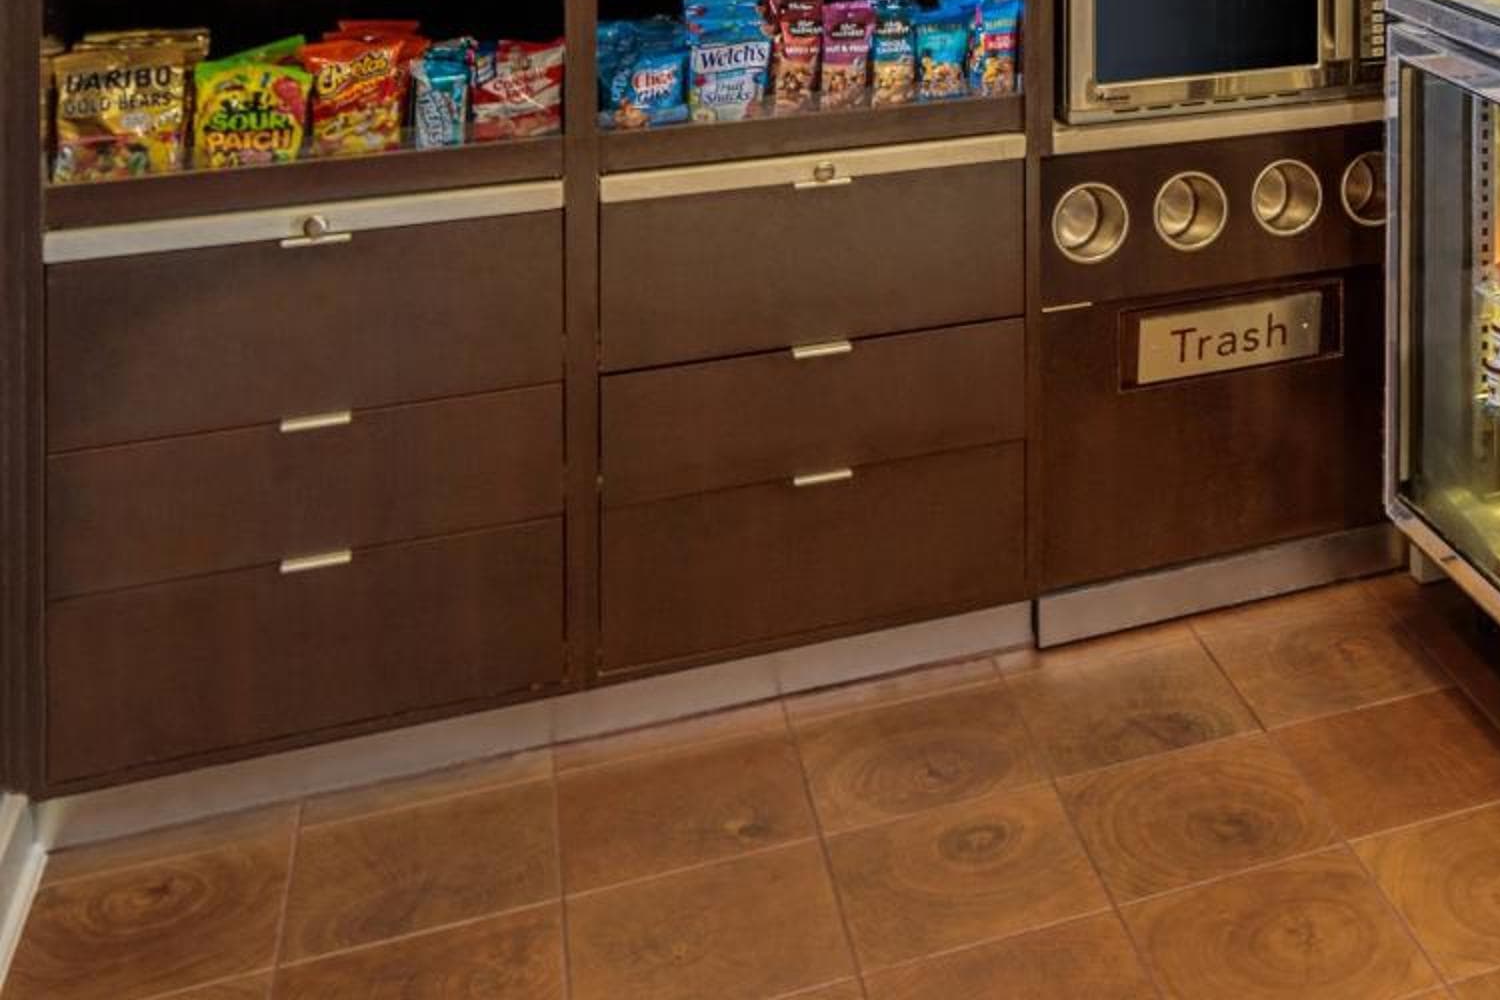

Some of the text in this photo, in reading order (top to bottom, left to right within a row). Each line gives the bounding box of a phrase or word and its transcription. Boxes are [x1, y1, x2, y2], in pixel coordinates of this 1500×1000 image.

[700, 43, 766, 69] Welch's
[66, 65, 171, 93] HARIBO
[211, 111, 289, 131] SOUR
[206, 129, 291, 151] PATCH
[1170, 312, 1288, 363] Trash
